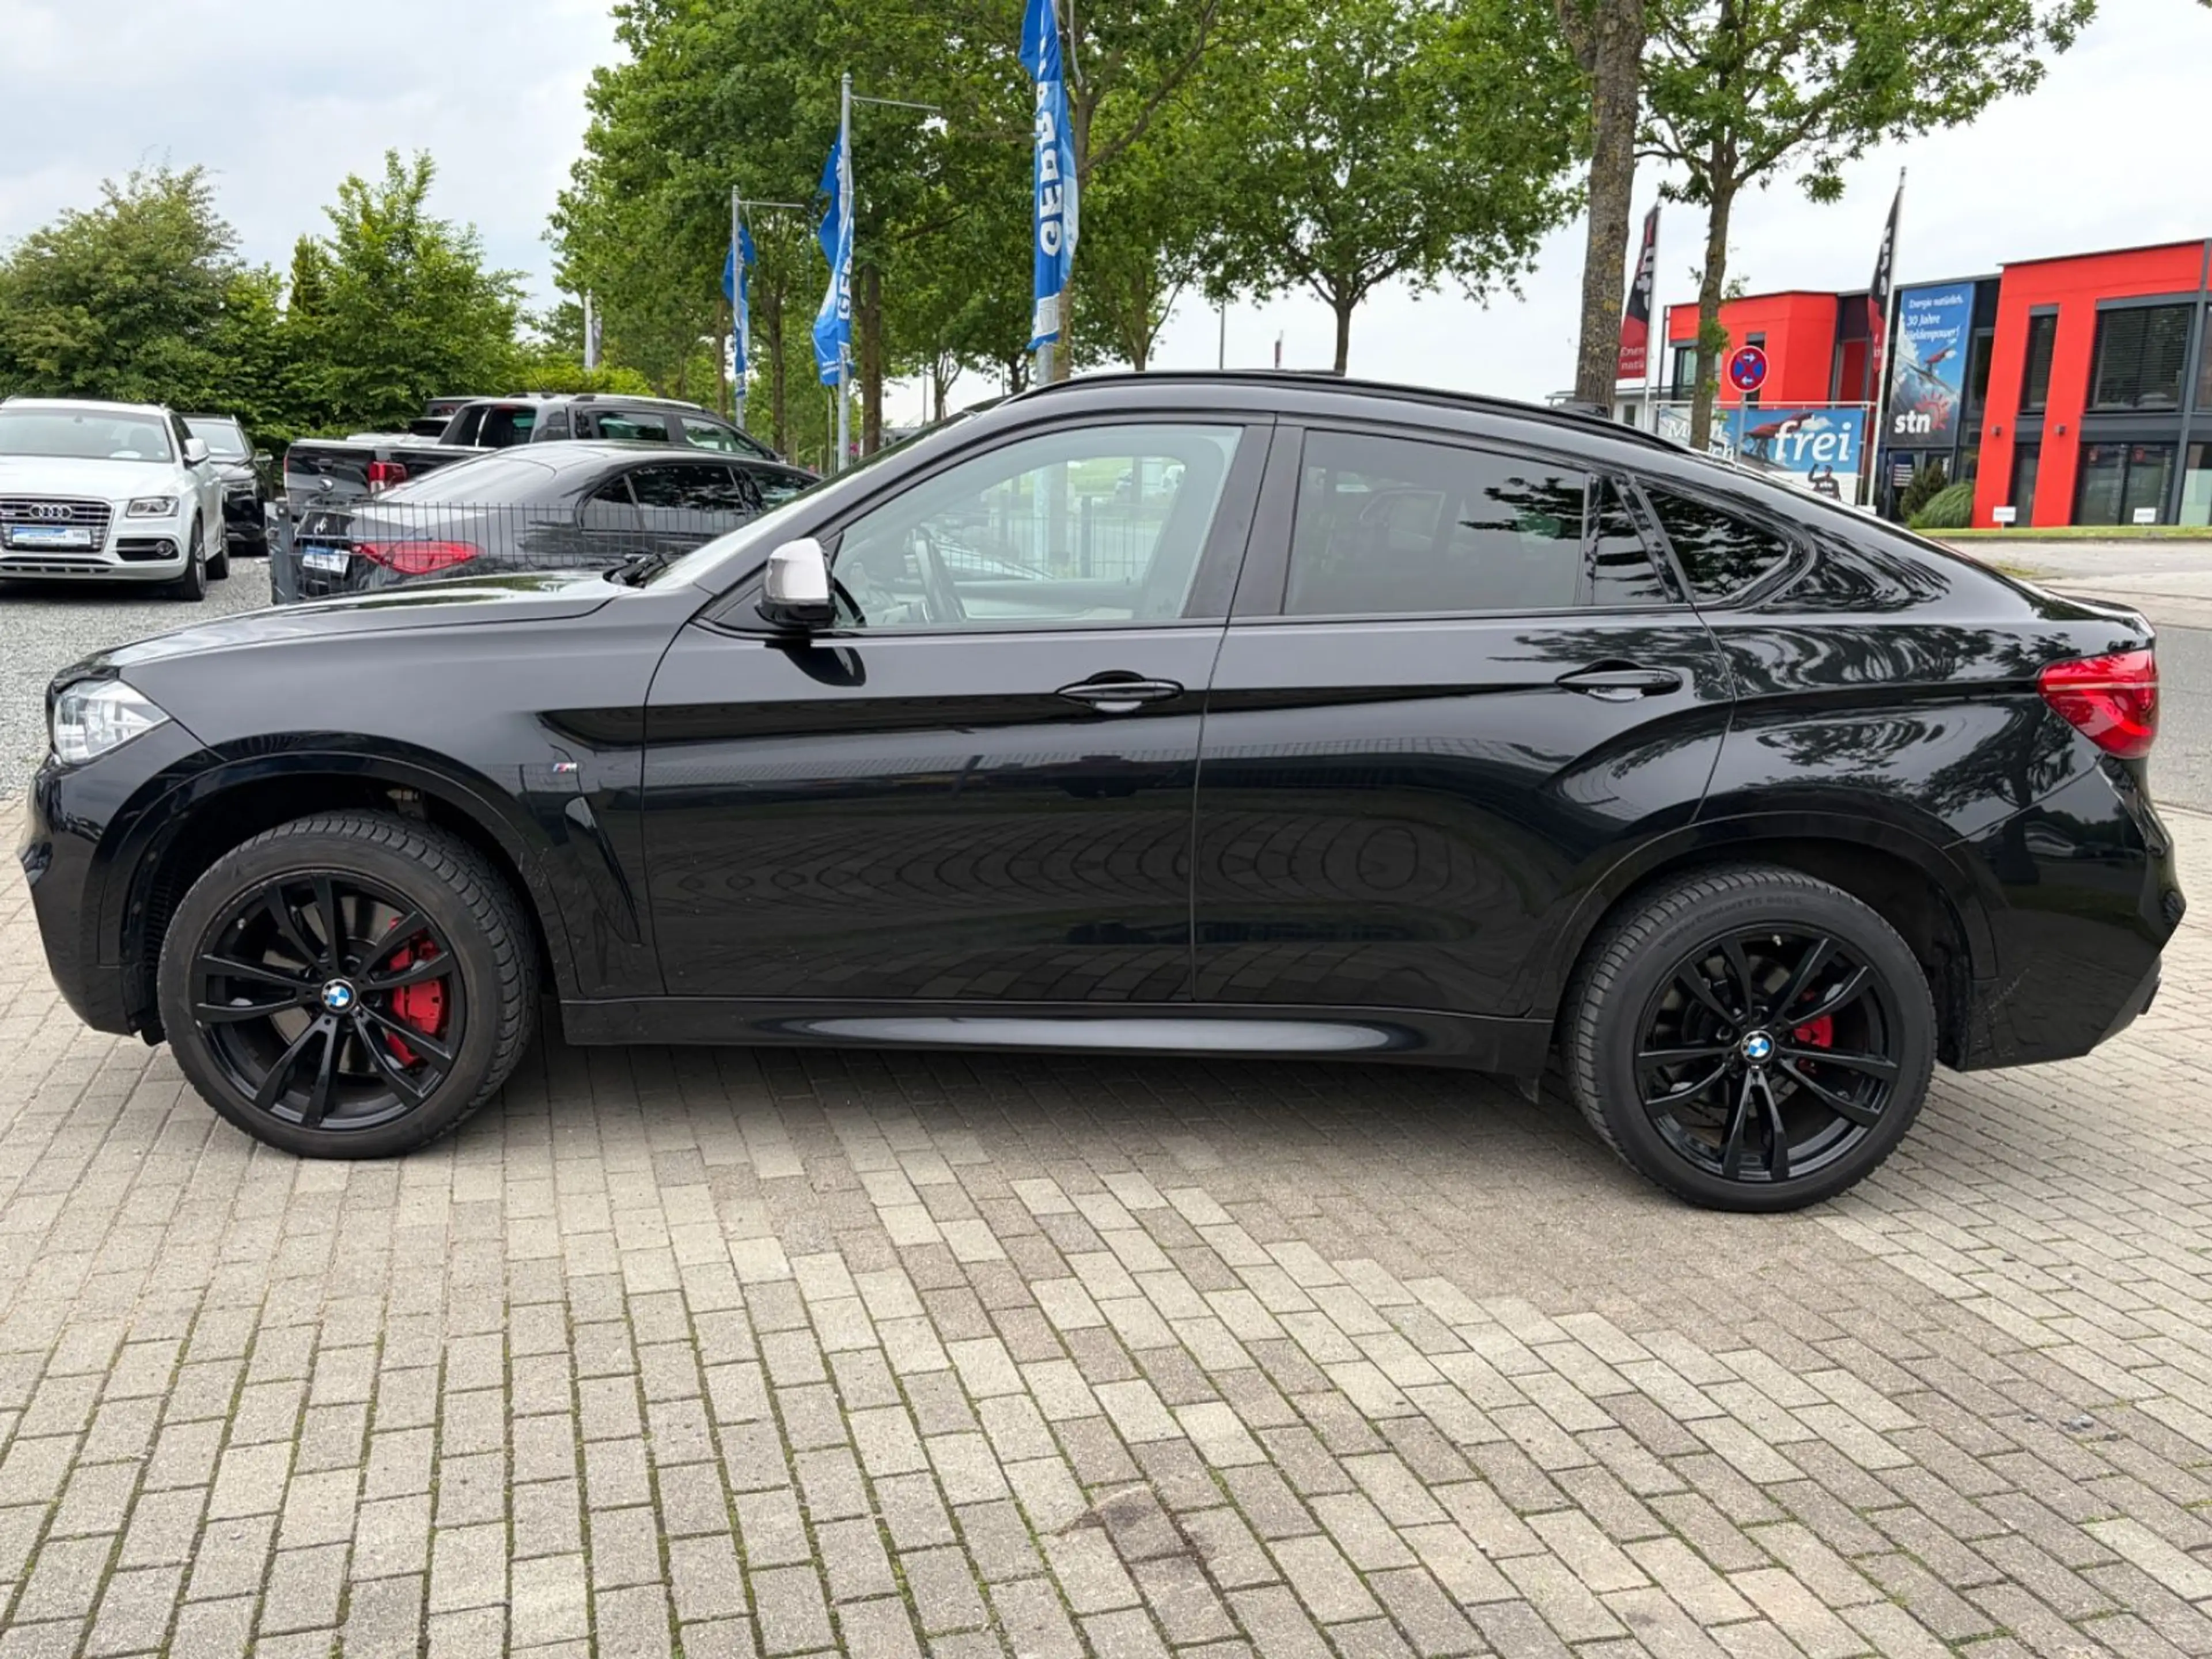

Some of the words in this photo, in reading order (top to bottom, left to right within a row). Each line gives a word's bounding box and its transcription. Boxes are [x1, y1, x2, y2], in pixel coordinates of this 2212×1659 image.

[1906, 315, 1918, 327] 30
[1894, 410, 1930, 434] stn
[1774, 420, 1851, 461] frei
